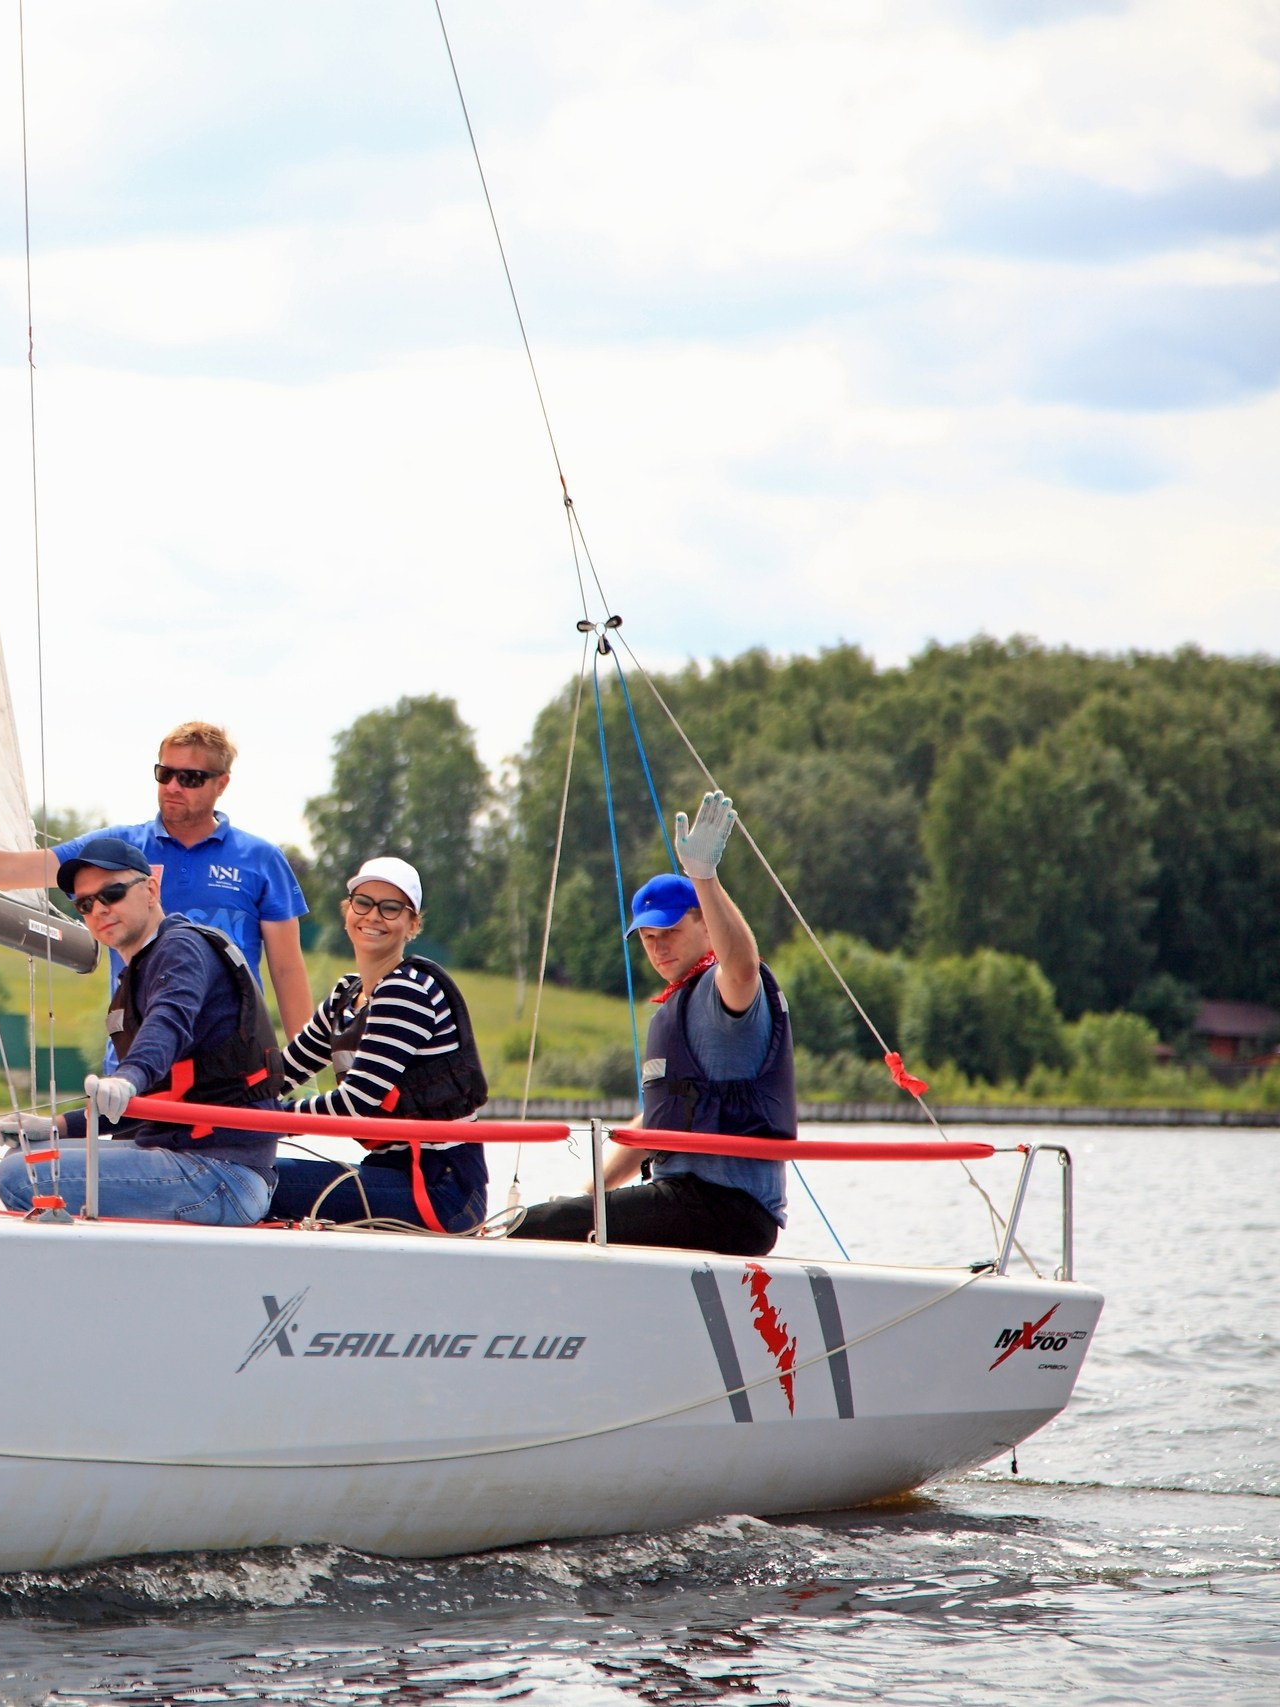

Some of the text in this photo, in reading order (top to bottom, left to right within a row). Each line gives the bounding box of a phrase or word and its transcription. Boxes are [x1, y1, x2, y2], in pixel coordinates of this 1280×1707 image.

[208, 864, 242, 883] NSL
[302, 1333, 480, 1359] SAILING
[483, 1335, 588, 1361] CLUB
